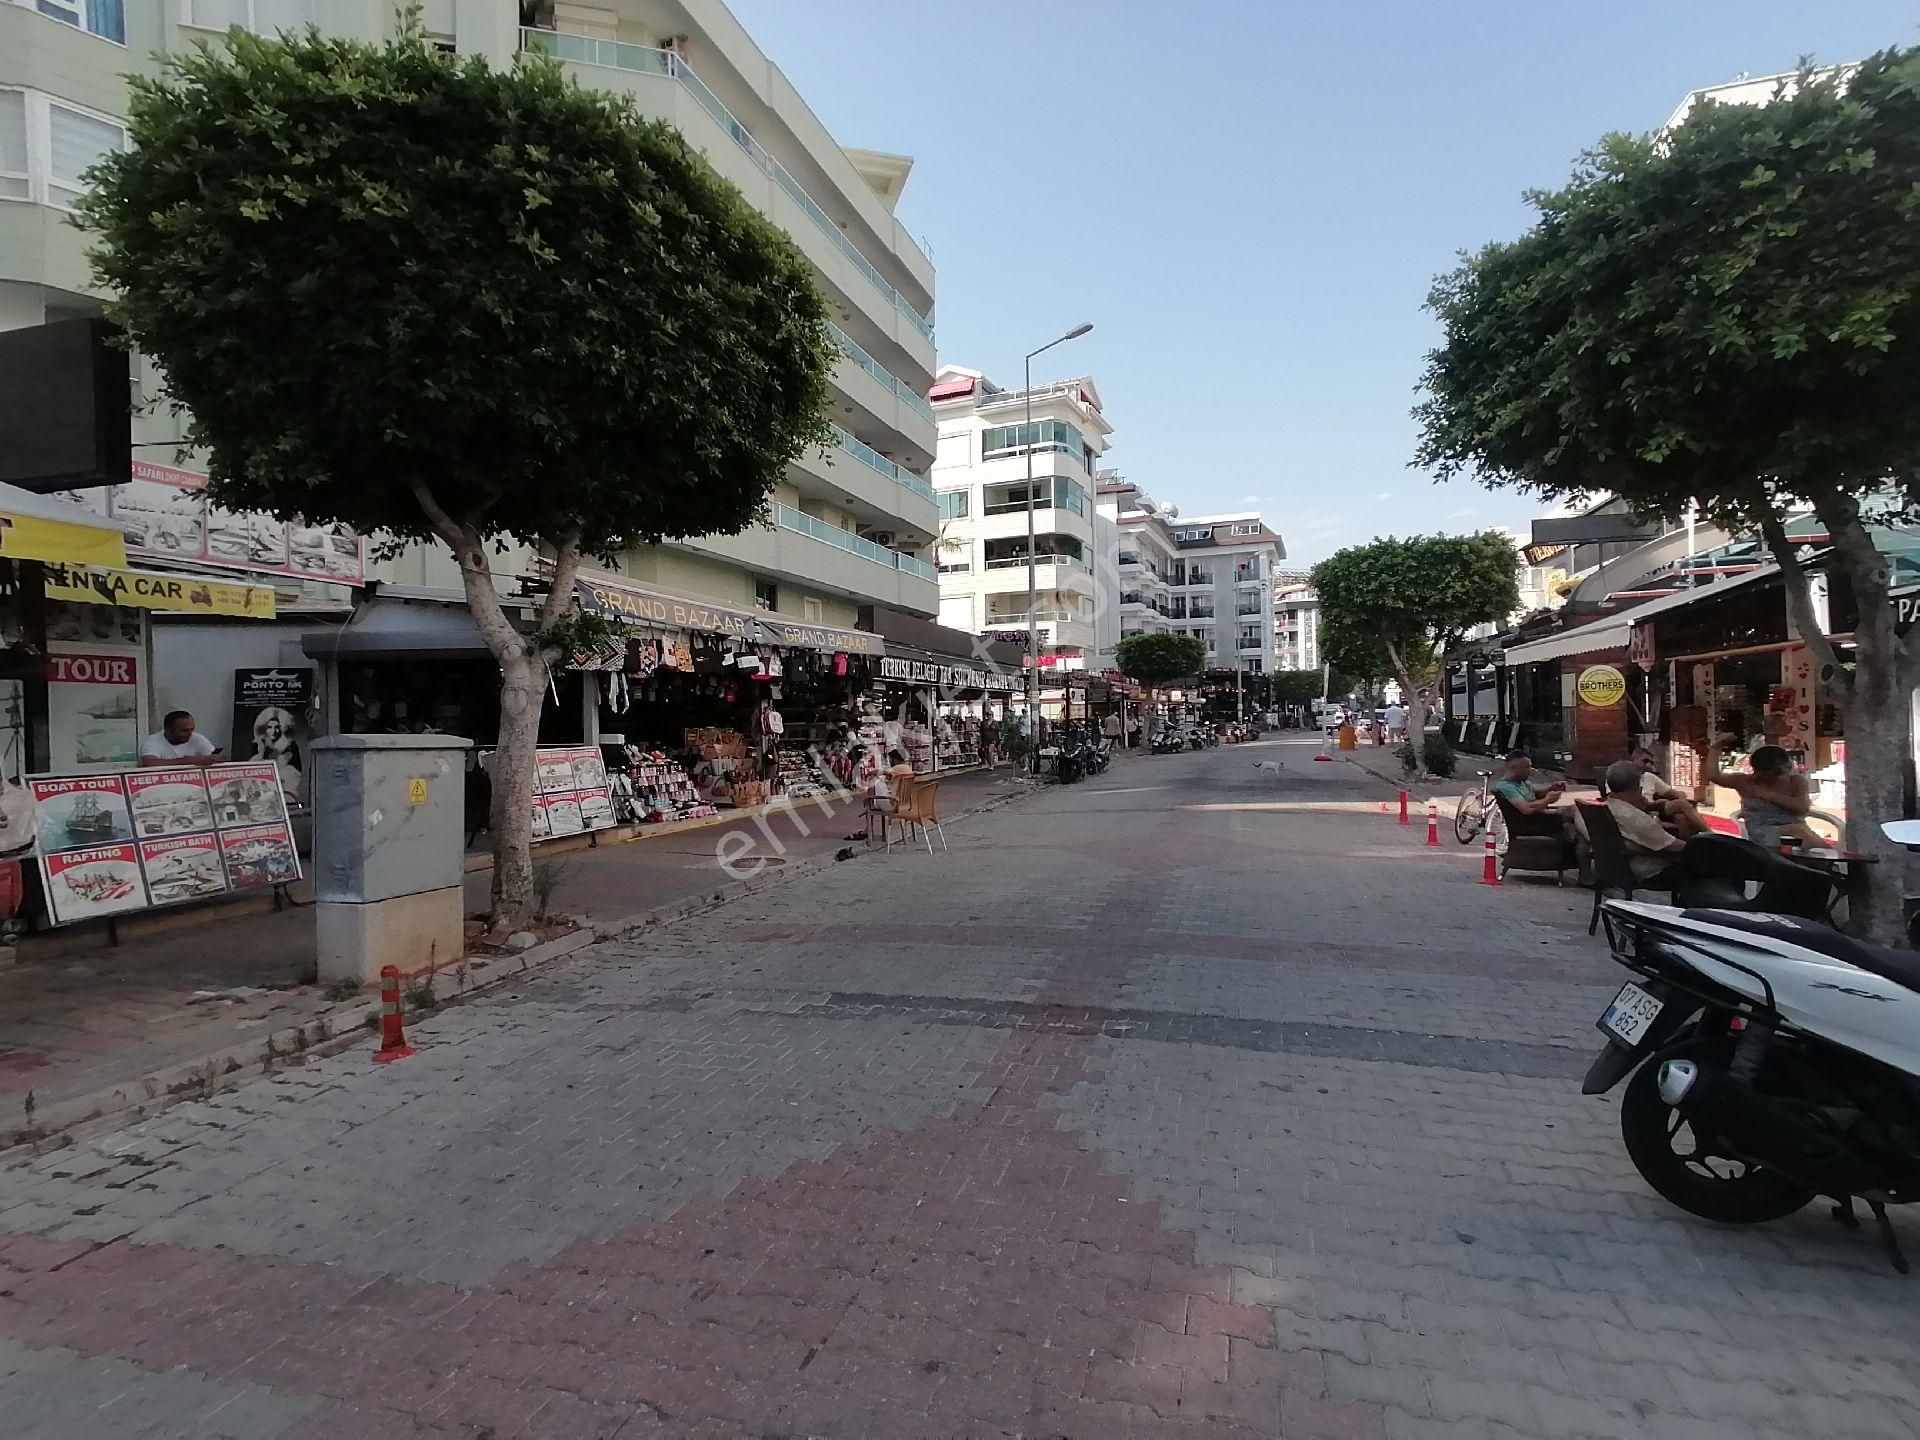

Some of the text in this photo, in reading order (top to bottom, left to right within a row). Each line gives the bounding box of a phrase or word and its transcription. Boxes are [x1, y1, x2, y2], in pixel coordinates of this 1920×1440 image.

[113, 576, 129, 593] A
[135, 578, 182, 599] CAR
[592, 590, 745, 633] GRAND BAZAAR
[784, 627, 869, 650] GRAND BAZAAR
[51, 658, 130, 682] TOUR
[880, 657, 911, 679] TURKISH
[1580, 680, 1623, 691] BROTHERS
[37, 780, 116, 793] BOAT TOUR
[131, 773, 200, 786] JEEP SAFARI
[146, 836, 212, 853] TURKISH BATH
[61, 848, 122, 864] RAFTING
[1619, 987, 1659, 1020] 07 ASG
[1614, 1011, 1639, 1036] 852
